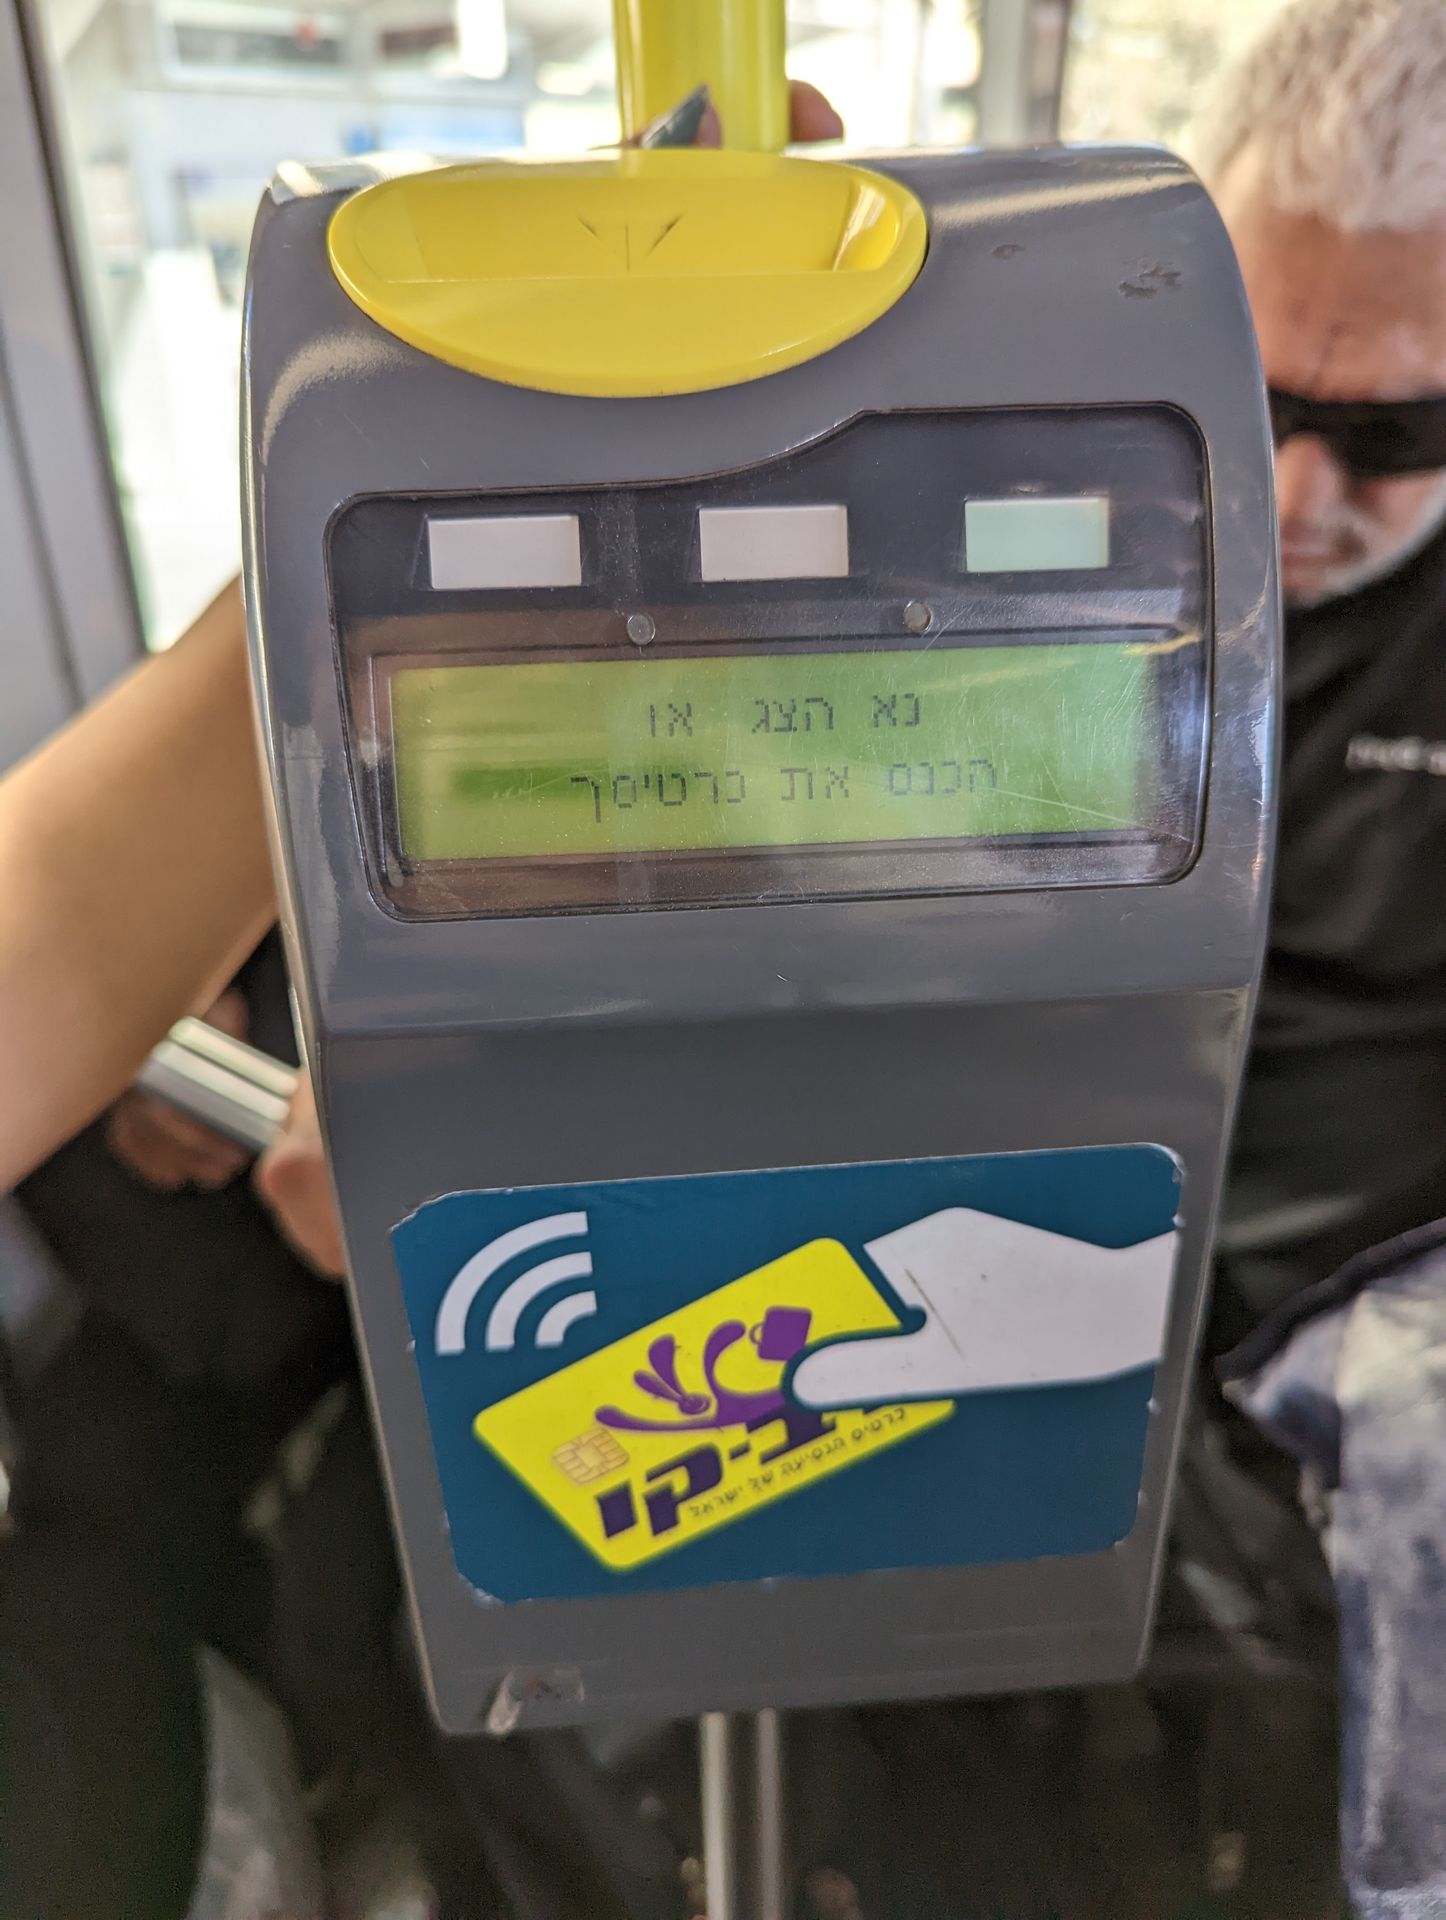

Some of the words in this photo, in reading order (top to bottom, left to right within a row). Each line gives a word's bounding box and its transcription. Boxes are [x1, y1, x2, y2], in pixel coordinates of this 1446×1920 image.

[649, 702, 692, 737] או
[752, 697, 834, 734] הצג
[873, 693, 920, 728] נא
[780, 766, 849, 801] את
[889, 759, 997, 796] הכנס
[570, 770, 746, 823] כרטיסך
